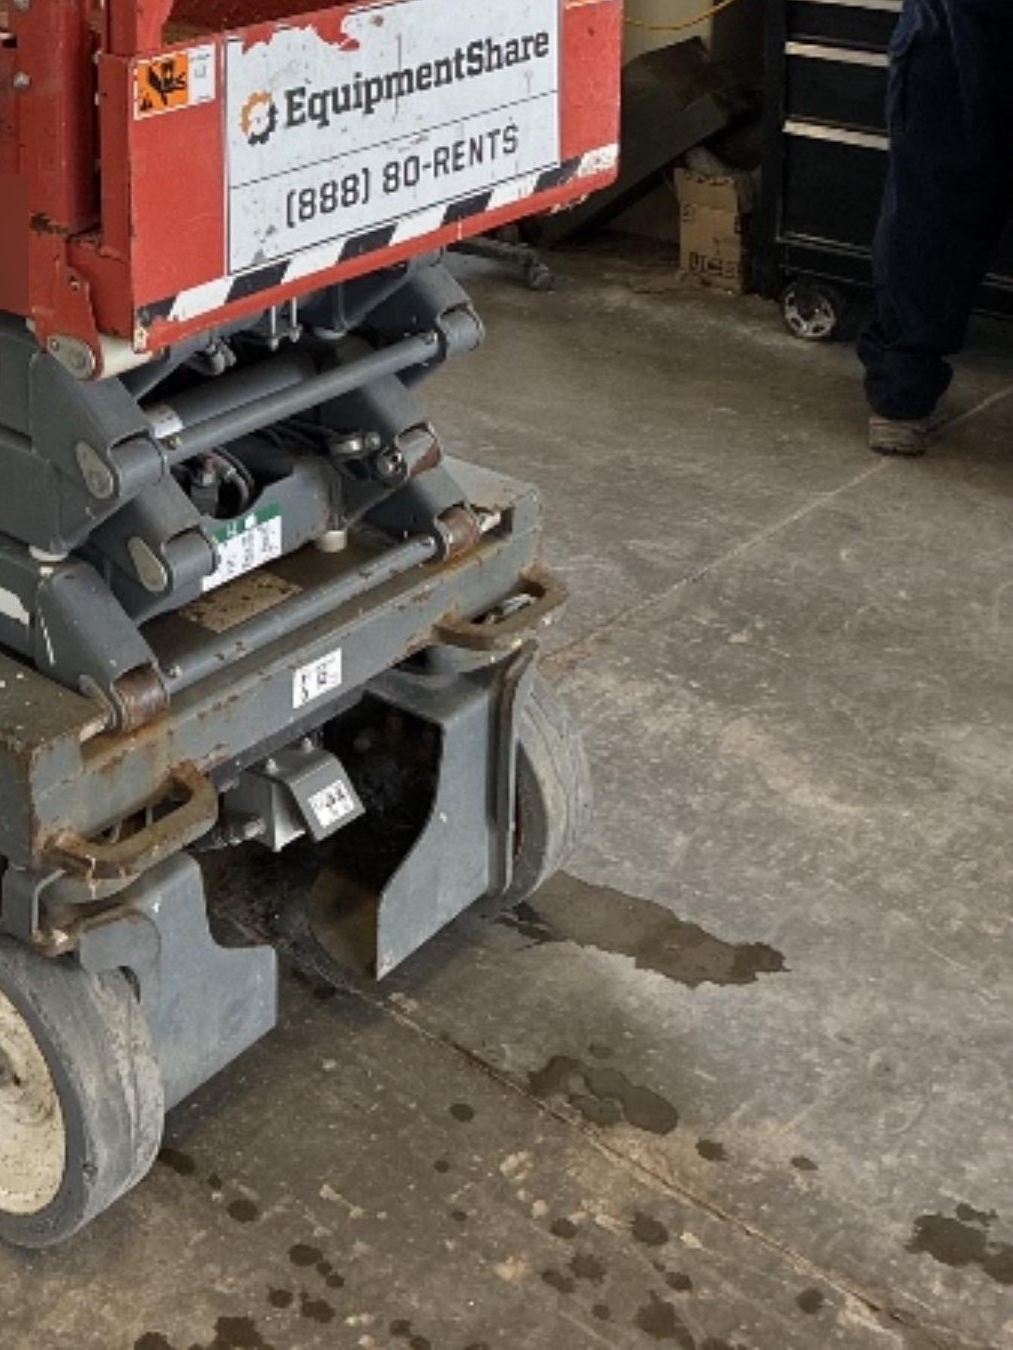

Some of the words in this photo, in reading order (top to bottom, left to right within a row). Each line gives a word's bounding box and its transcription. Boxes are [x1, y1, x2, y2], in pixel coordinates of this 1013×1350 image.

[283, 31, 550, 130] EquipmentShare
[286, 167, 371, 229] (888)
[382, 123, 520, 194] 80-RENTS
